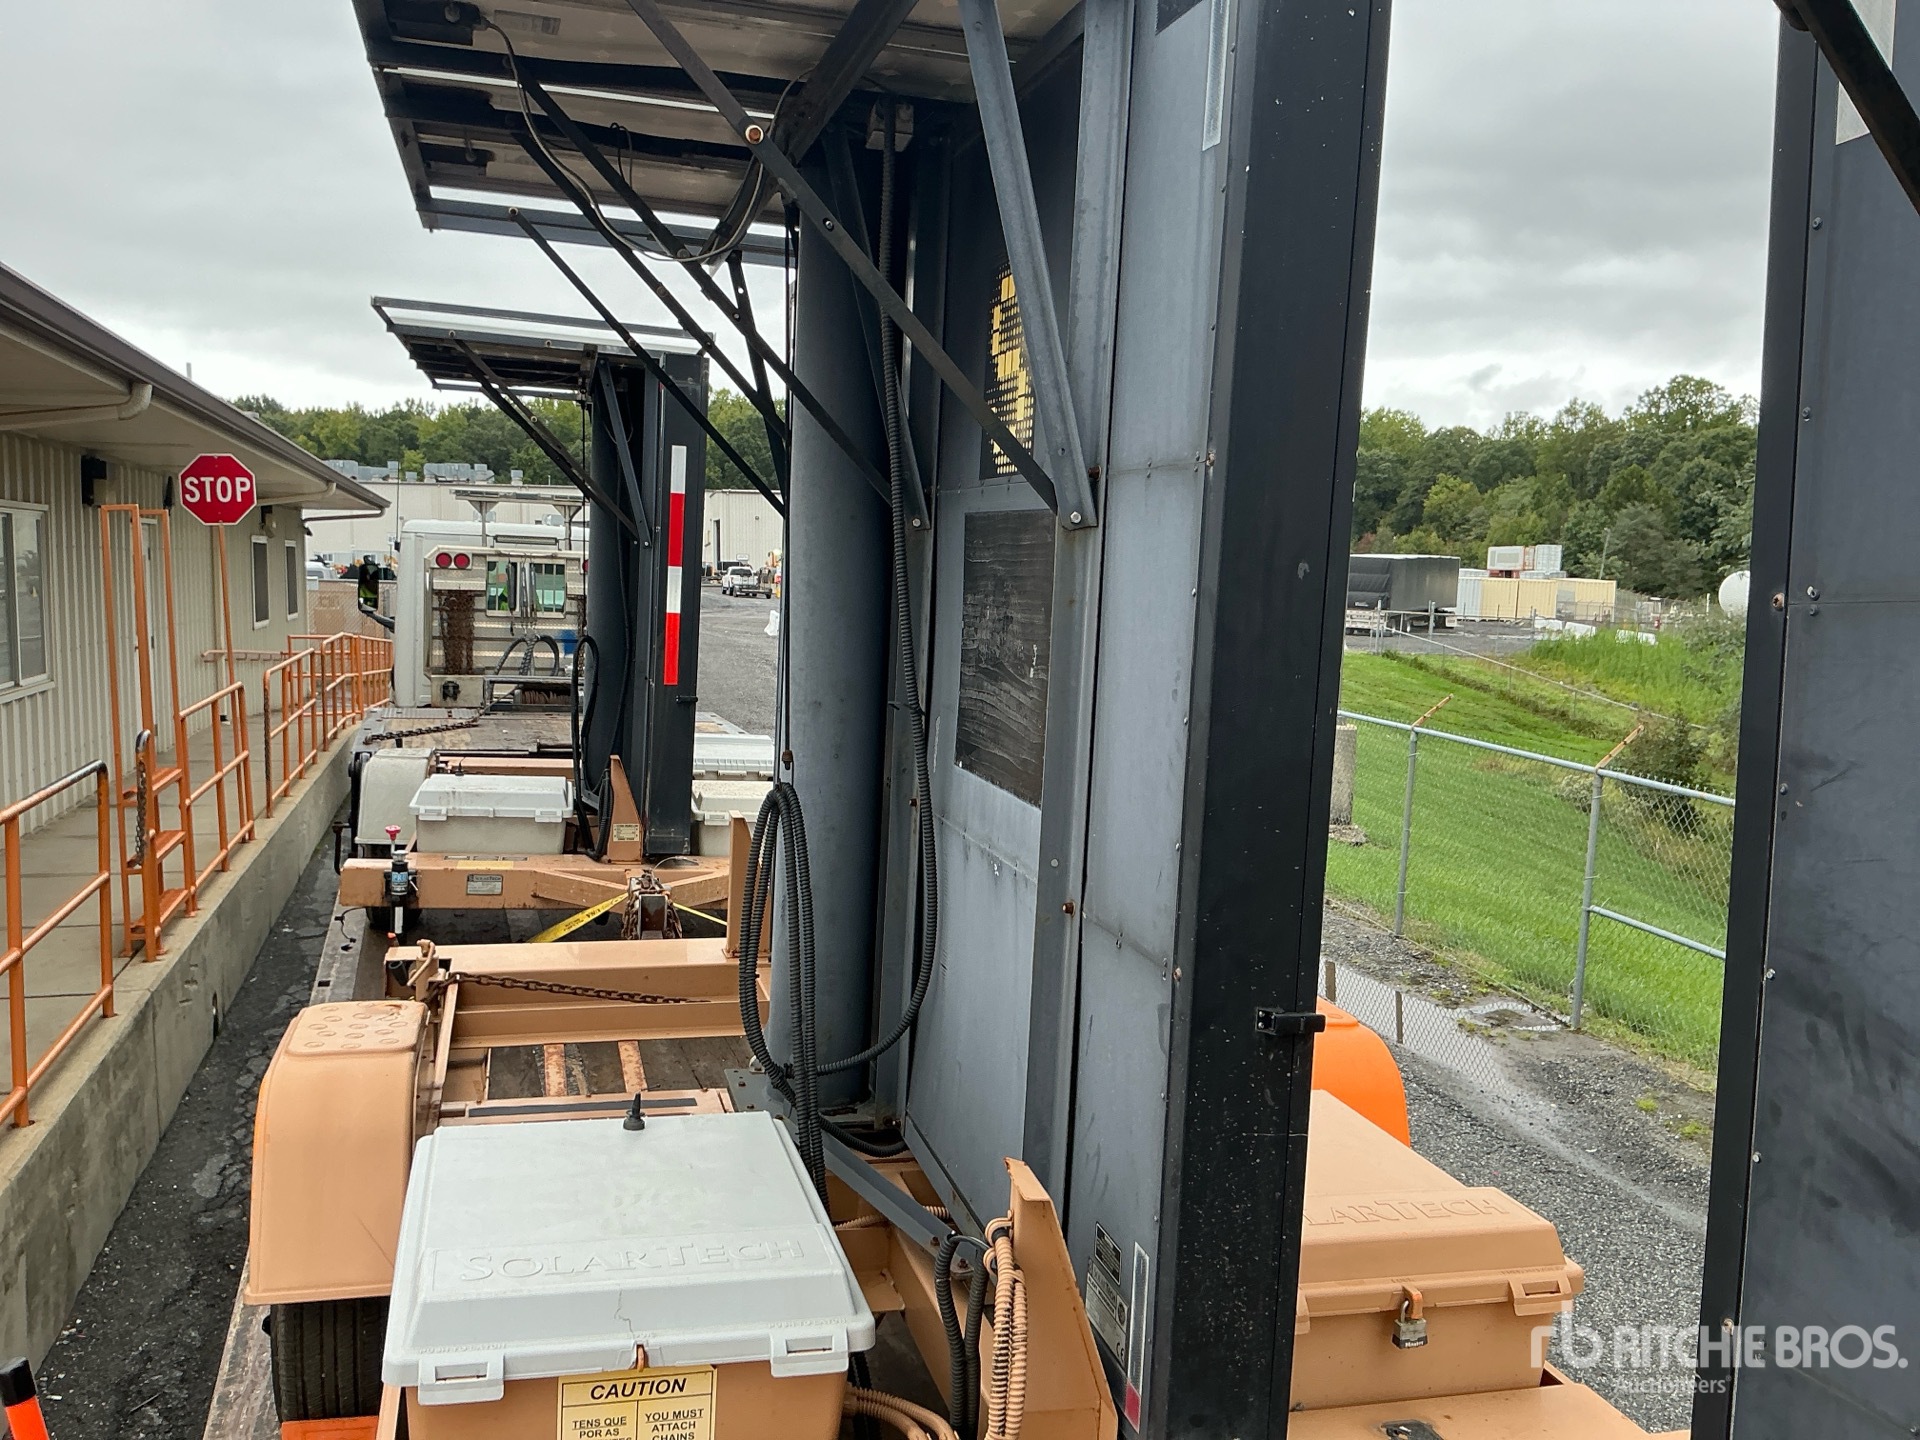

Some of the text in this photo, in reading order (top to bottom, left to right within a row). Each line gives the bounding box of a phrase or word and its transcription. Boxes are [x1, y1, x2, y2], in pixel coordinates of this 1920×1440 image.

[184, 476, 251, 503] STOP
[1302, 1198, 1510, 1227] LARTECH
[590, 1378, 687, 1400] CAUTION
[645, 1408, 705, 1422] YOU MUST
[572, 1416, 627, 1429] TENS QUE
[651, 1421, 696, 1432] ATTACH
[579, 1429, 603, 1439] POR
[604, 1428, 620, 1437] AS
